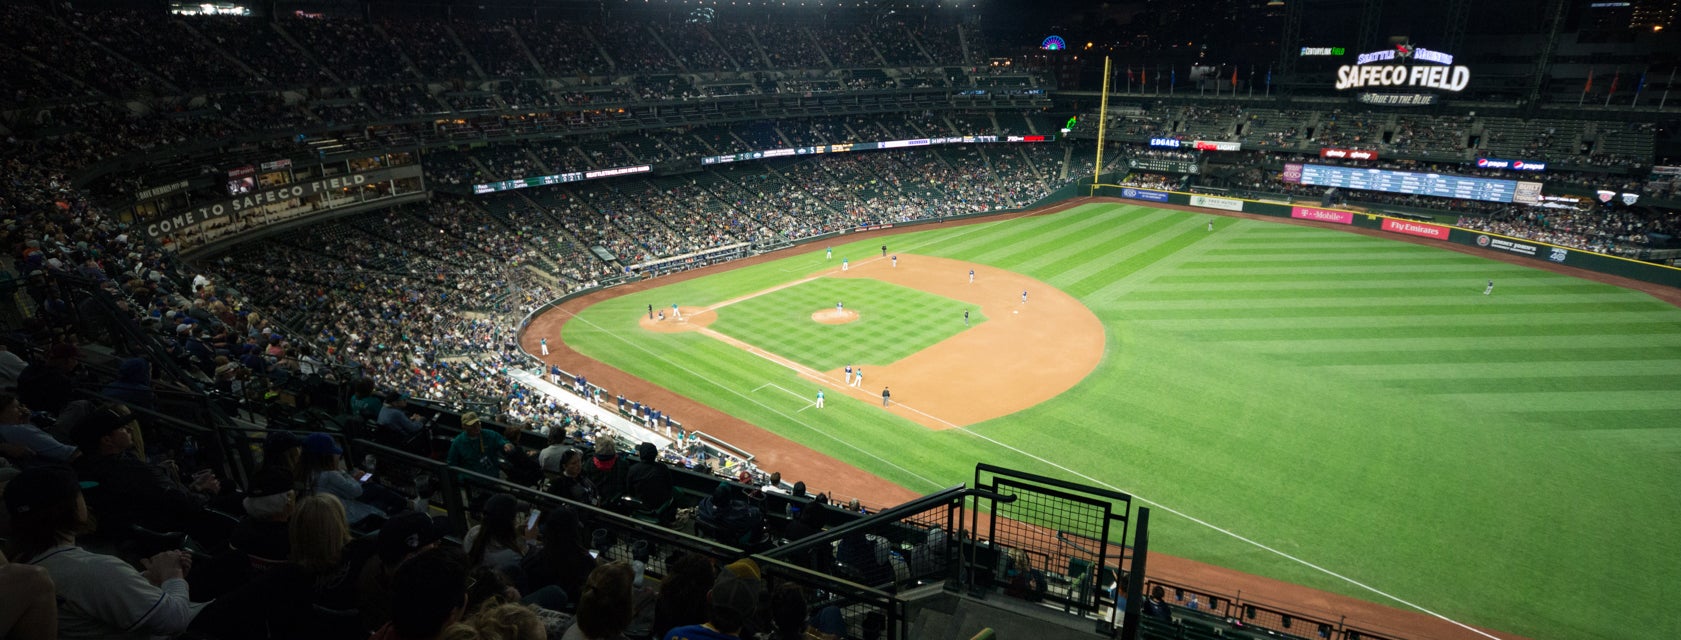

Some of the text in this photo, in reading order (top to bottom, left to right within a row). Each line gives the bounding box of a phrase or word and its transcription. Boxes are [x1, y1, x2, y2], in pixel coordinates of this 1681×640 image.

[1357, 50, 1395, 65] SEATTLE
[1335, 65, 1470, 91] SAFECO FIELD
[1370, 93, 1432, 104] TRUE TO THE BLUE
[148, 174, 365, 237] COME TO SAFECO FIELD
[1391, 221, 1440, 236] Fly Emirates
